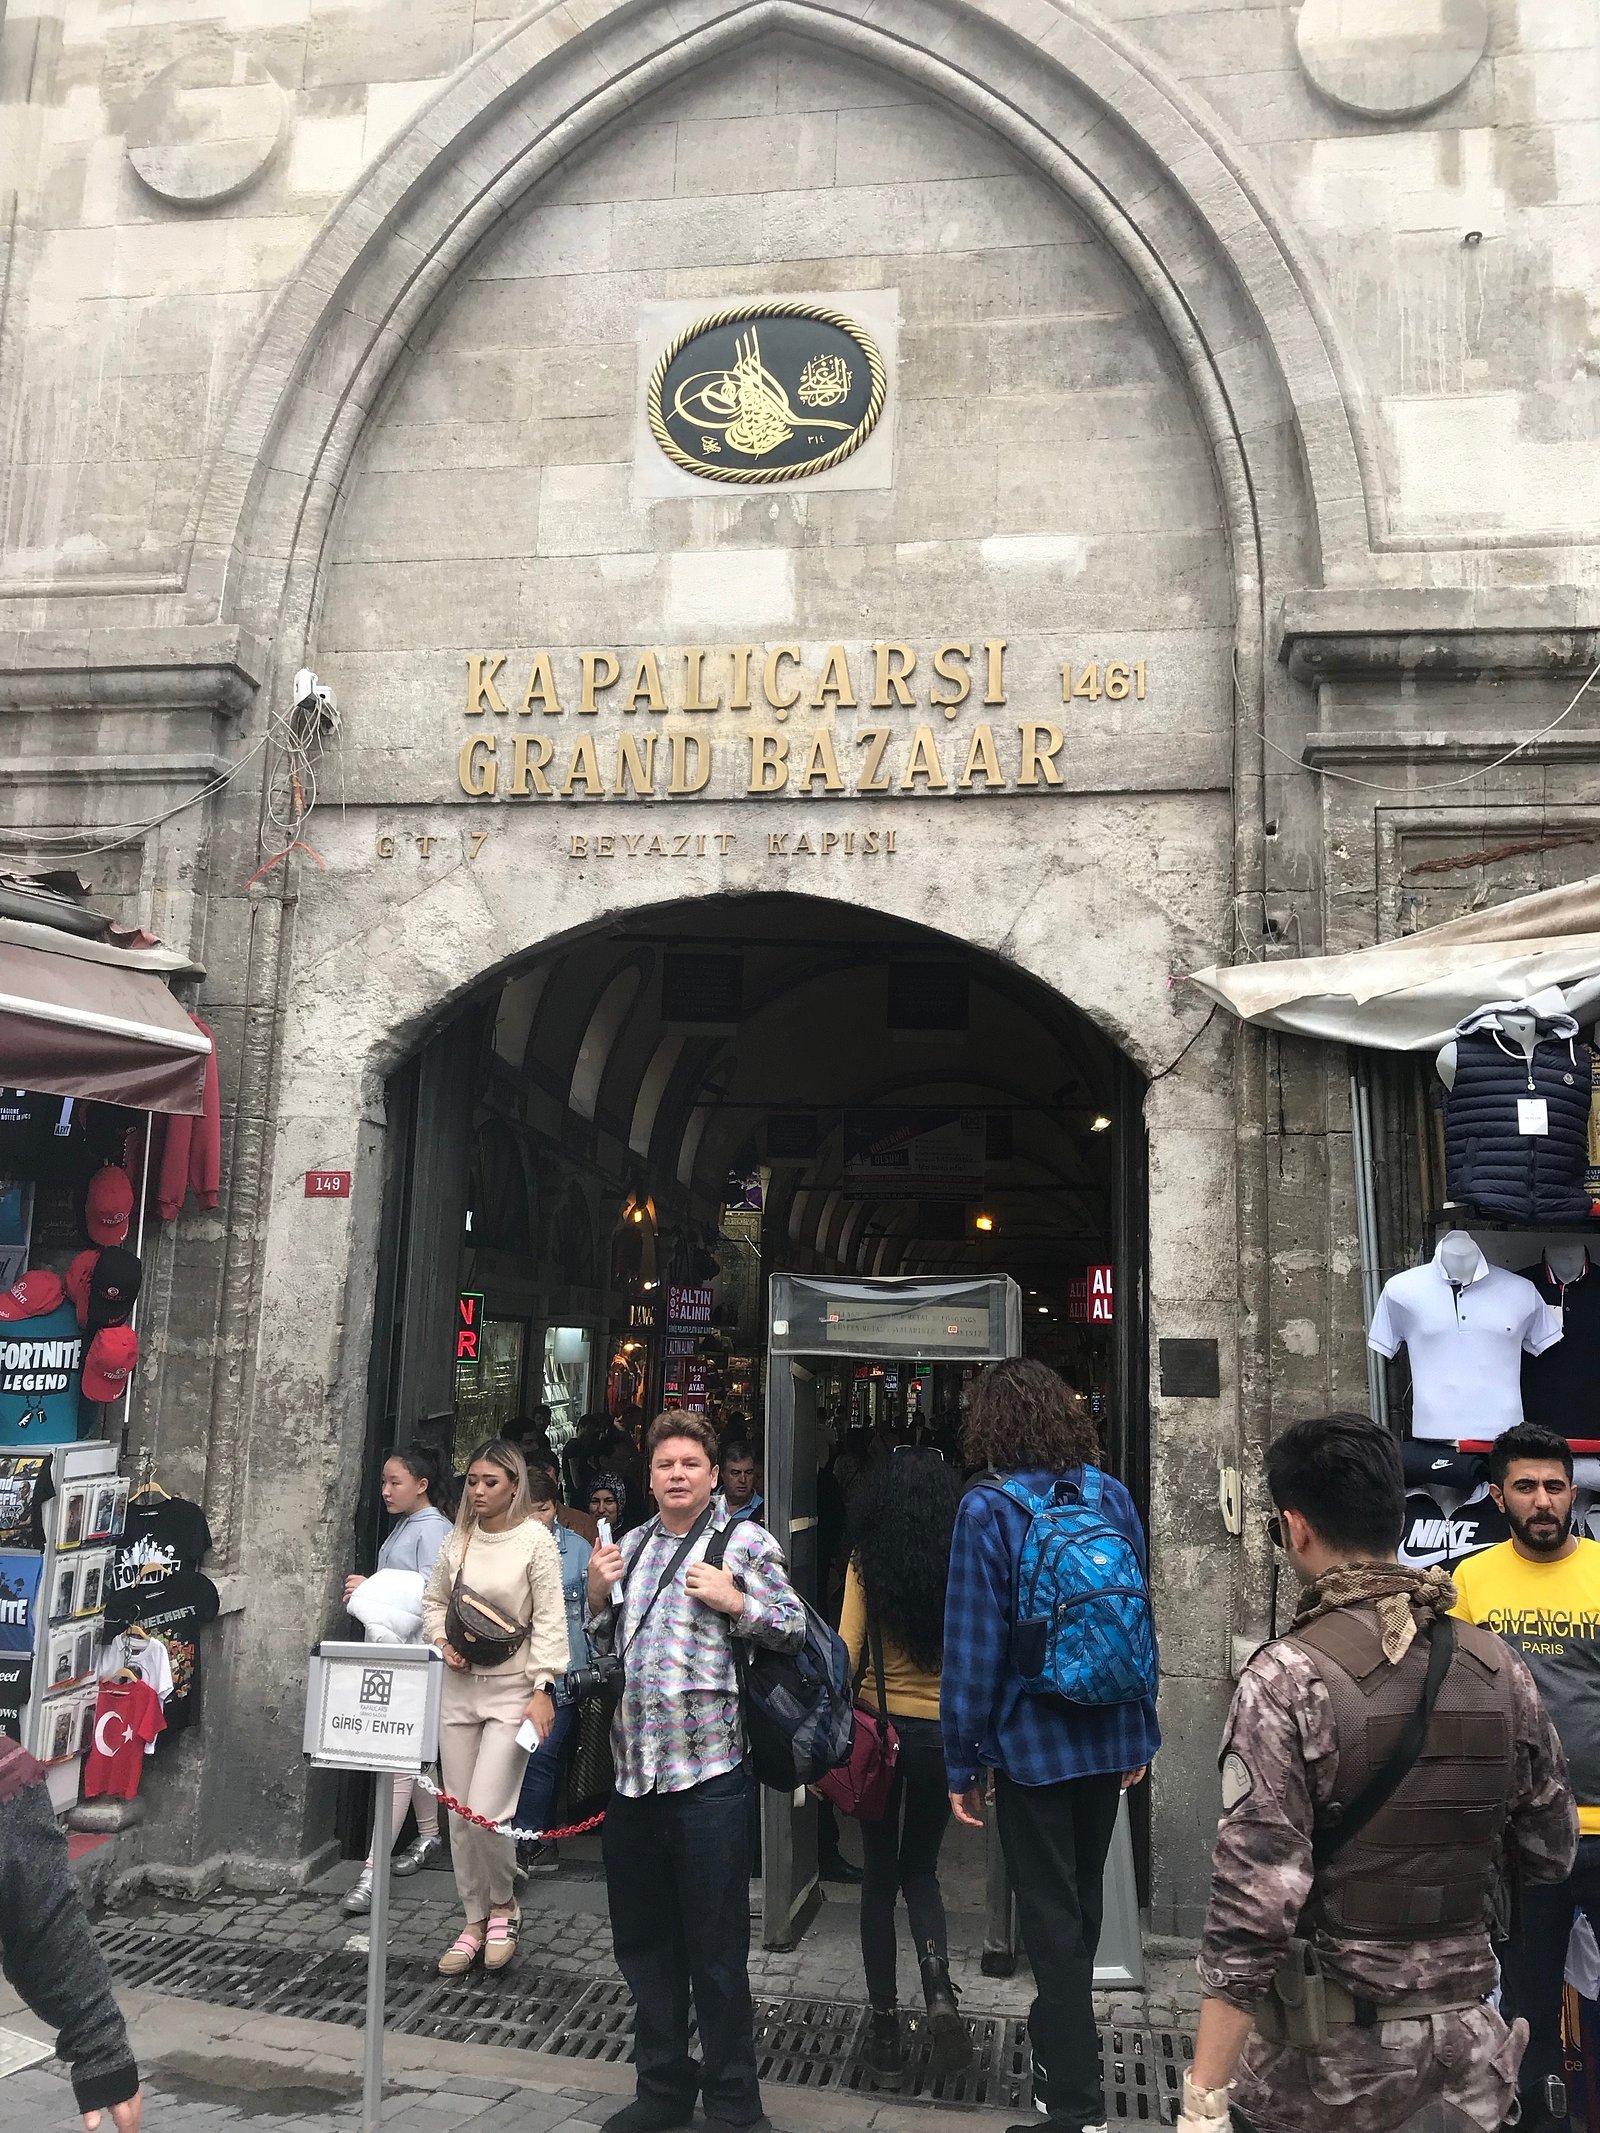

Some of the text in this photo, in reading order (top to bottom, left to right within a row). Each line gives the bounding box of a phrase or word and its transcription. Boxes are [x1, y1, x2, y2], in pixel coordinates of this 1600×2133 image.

[463, 639, 1147, 721] KAPALIÇARŞI 1461
[458, 721, 1066, 797] GRAND BAZAAR
[469, 831, 488, 860] 7
[569, 830, 898, 859] BEYAZIT KAPISI
[315, 1177, 341, 1191] 149
[680, 1288, 712, 1305] ALTIN
[679, 1305, 711, 1321] ALINIR
[0, 1339, 82, 1371] FORTNITE
[3, 1373, 68, 1391] LEGEND
[1406, 1518, 1480, 1548] NIKE
[142, 1605, 197, 1629] NECRAFT
[1487, 1607, 1600, 1640] GIVENCHY
[1521, 1641, 1565, 1655] PARIS
[331, 1714, 363, 1734] GİRİŞ
[372, 1720, 415, 1736] ENTRY
